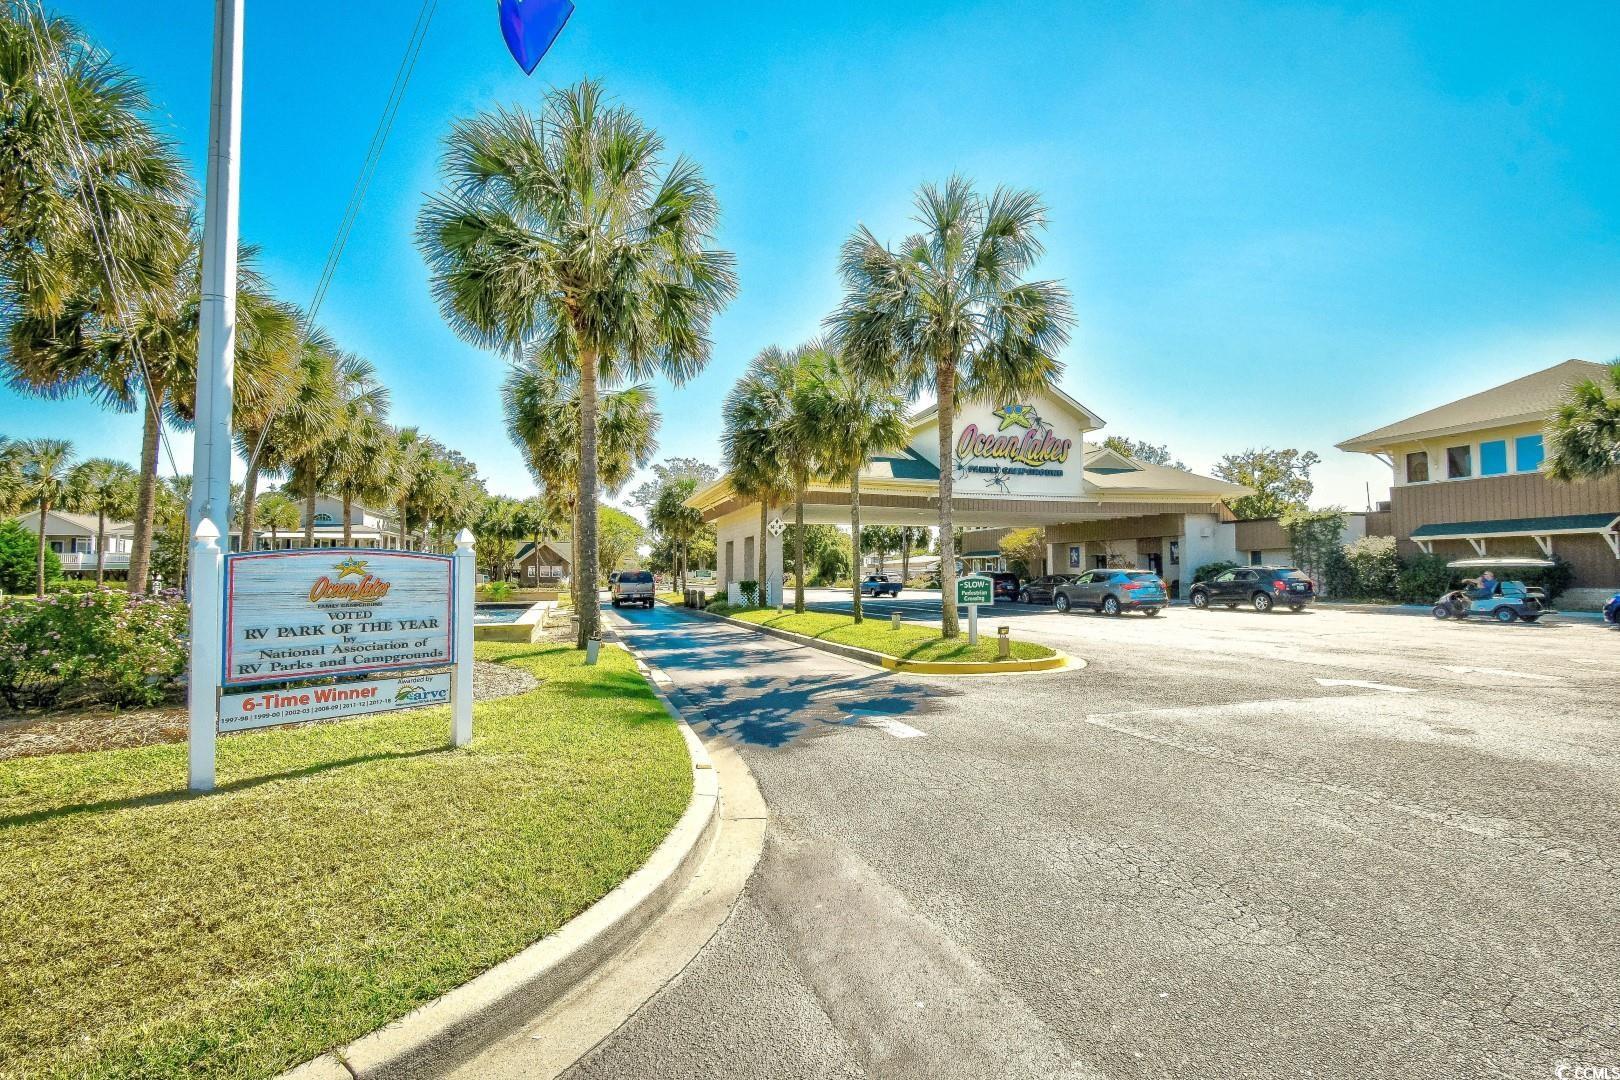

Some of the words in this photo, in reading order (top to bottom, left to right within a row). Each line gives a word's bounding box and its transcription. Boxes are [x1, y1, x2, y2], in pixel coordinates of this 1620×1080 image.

[956, 423, 1018, 459] Ocean
[1012, 428, 1072, 467] Lakes
[310, 575, 356, 603] Ocean
[351, 575, 391, 602] Lakes
[328, 610, 373, 621] VOTED
[244, 628, 270, 640] RV
[276, 624, 326, 637] PARK
[332, 623, 353, 635] OF
[358, 621, 393, 633] THE
[397, 618, 440, 630] YEAR
[343, 635, 357, 644] by
[259, 645, 326, 660] National
[332, 641, 409, 655] Association
[414, 638, 428, 647] of
[239, 663, 262, 675] RV
[270, 659, 313, 672] Parks
[319, 656, 347, 668] and
[352, 649, 443, 665] Campgrounds
[397, 677, 424, 685] Awarded
[242, 694, 310, 712] 6-Time
[314, 685, 378, 704] Winner
[221, 716, 249, 724] 1997-98
[254, 712, 281, 720] 1999-00
[285, 708, 310, 716] 2002-03
